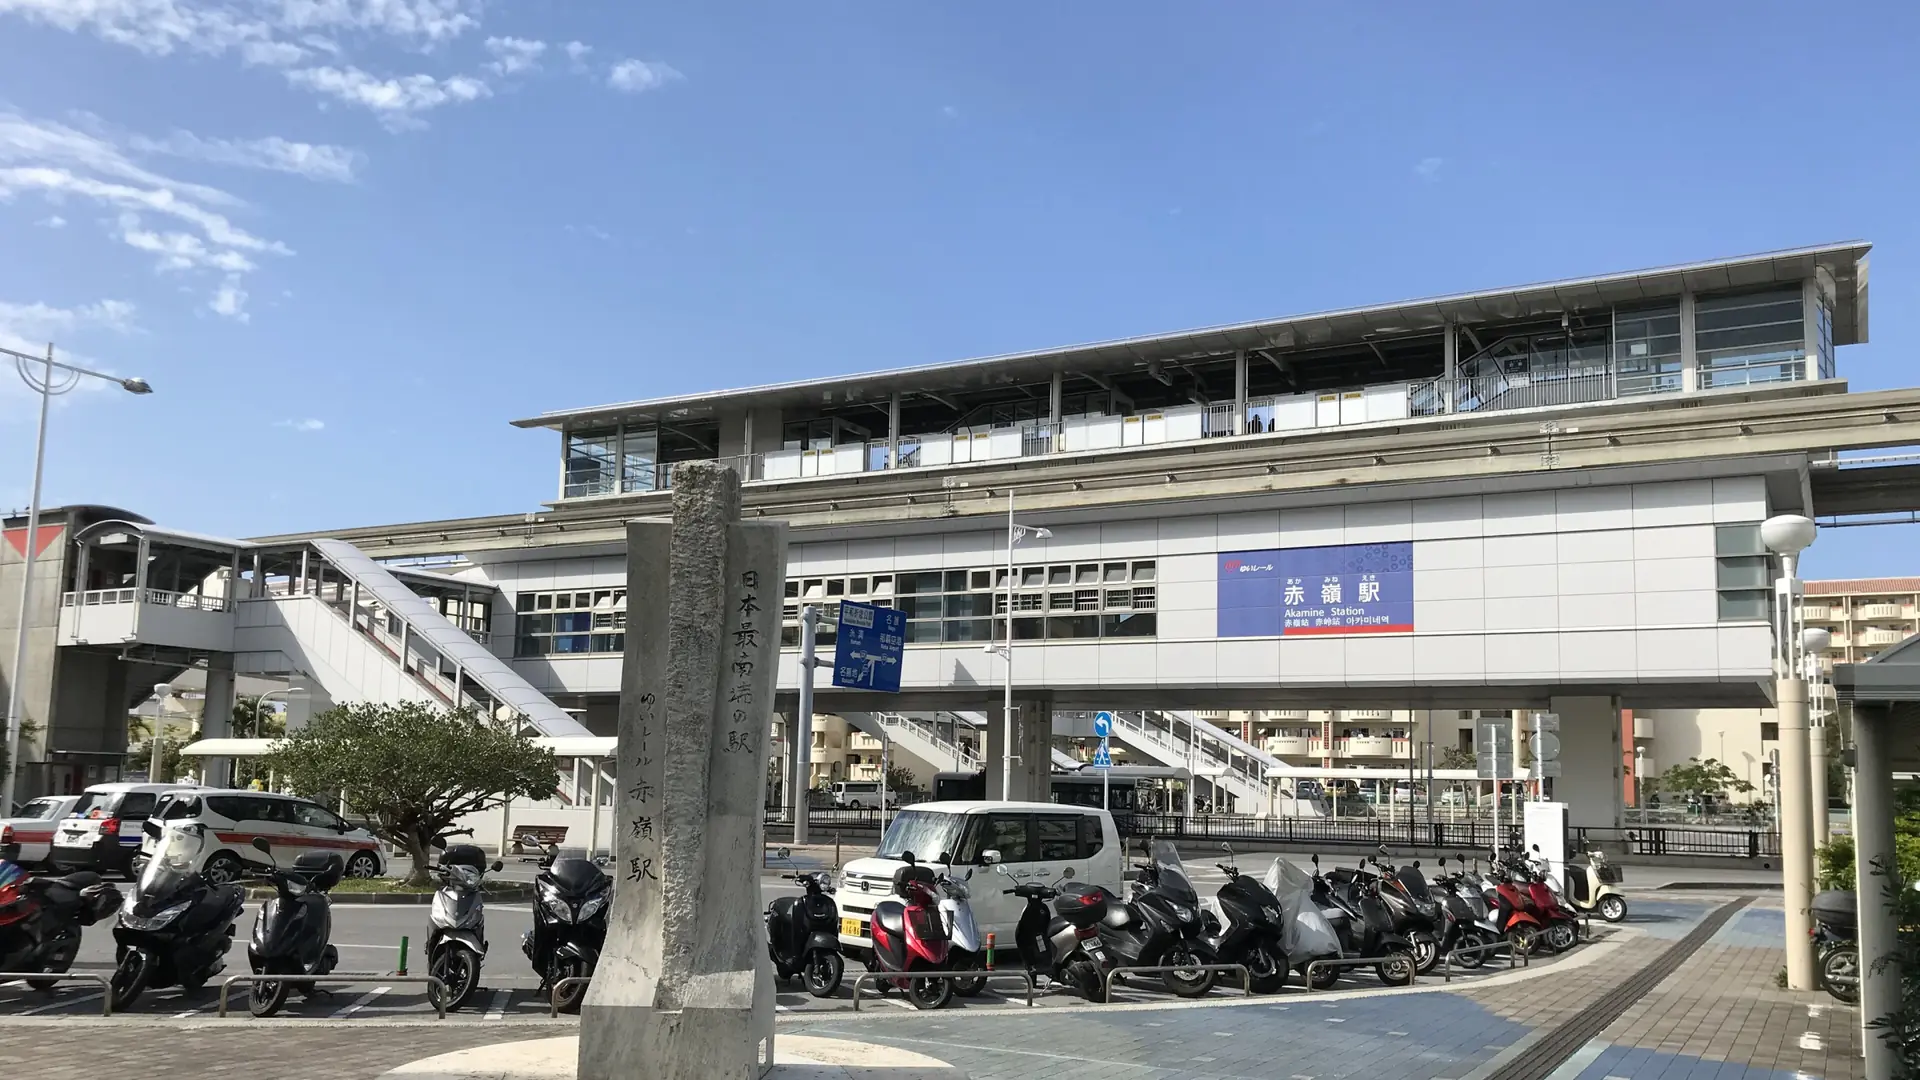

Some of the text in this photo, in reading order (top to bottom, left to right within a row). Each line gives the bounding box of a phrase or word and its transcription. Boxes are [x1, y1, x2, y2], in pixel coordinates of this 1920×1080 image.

[1239, 563, 1273, 572] ゆいレール
[1284, 581, 1380, 605] 赤嶺駅
[1284, 606, 1365, 618] Akamine Station
[1346, 615, 1389, 626] 아카미네역
[723, 571, 762, 754] 日本最南端の駅
